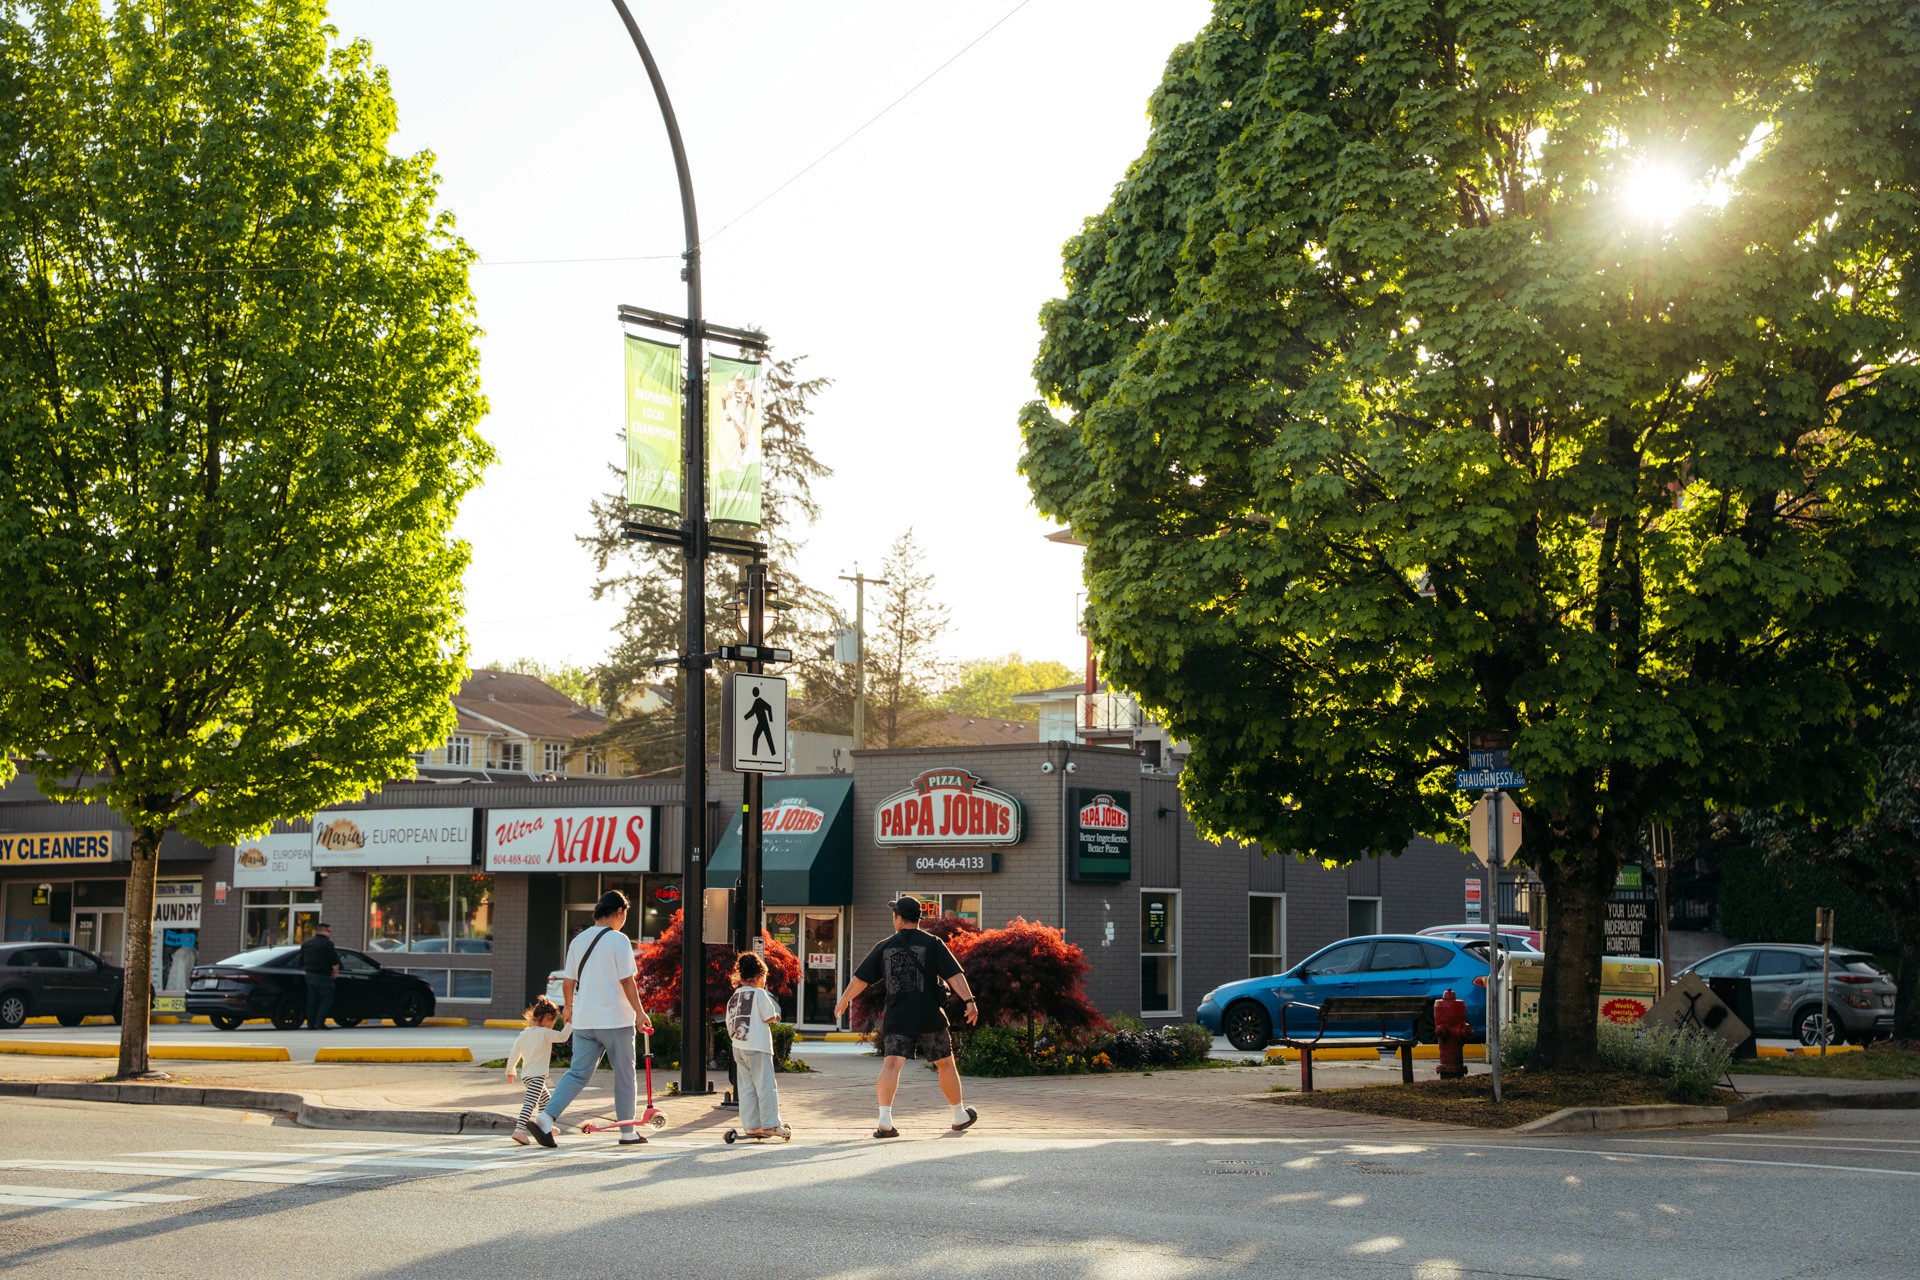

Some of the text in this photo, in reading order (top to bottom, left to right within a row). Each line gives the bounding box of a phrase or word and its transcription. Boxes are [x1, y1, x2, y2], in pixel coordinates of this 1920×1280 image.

[635, 389, 673, 407] INSPIRING
[643, 407, 666, 422] LOCAL
[632, 421, 677, 441] CHAMPIONS
[1470, 753, 1493, 769] WHYTE
[928, 775, 963, 787] PIZZA
[1458, 771, 1514, 788] SHAUGHNESSY
[762, 809, 780, 832] PA
[881, 794, 1010, 837] PAPA JOHN'S
[1081, 806, 1100, 826] PAPA
[373, 827, 438, 844] EUROPEAN
[441, 827, 468, 842] DELI
[495, 815, 644, 864] Ultra NAILS
[1080, 832, 1129, 844] Better Ingredients.
[17, 835, 109, 860] CLEANERS
[1088, 843, 1120, 854] Better Pizza.
[272, 862, 288, 871] DELI
[916, 857, 984, 869] 604-464-4133
[1615, 870, 1641, 886] shmart
[155, 903, 200, 921] AUNDRY
[920, 902, 940, 917] PEN
[1607, 903, 1647, 919] YOUR LOCAL
[1604, 920, 1643, 935] INDEPENDENT
[1606, 937, 1640, 952] HOMETOWN
